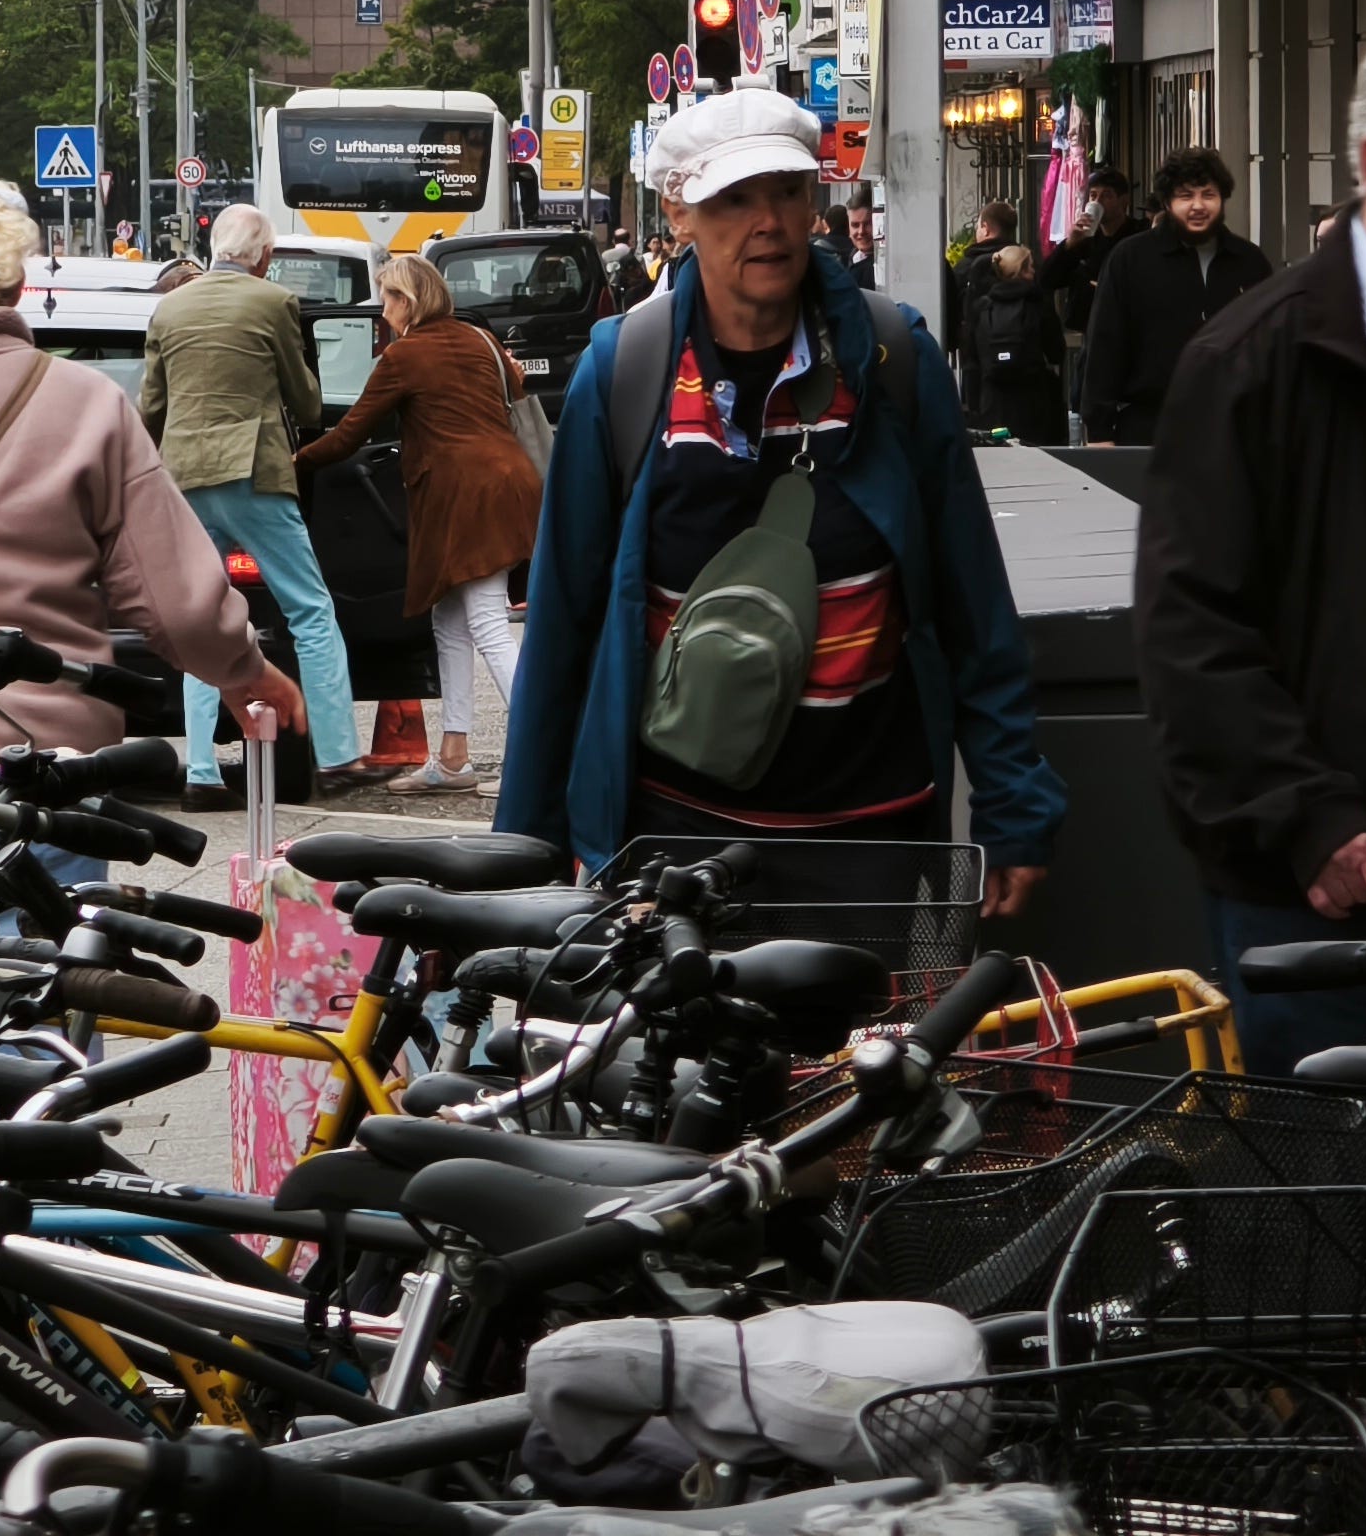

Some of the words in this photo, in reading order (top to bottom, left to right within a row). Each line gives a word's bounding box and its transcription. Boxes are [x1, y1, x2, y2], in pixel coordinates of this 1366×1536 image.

[945, 3, 1044, 25] chCar24
[945, 35, 981, 50] ent
[987, 37, 999, 50] a
[1006, 32, 1044, 49] Car
[557, 101, 570, 117] H
[336, 140, 404, 153] Lufthansa
[407, 143, 462, 155] express
[184, 166, 199, 178] 50
[437, 175, 476, 183] HVO100
